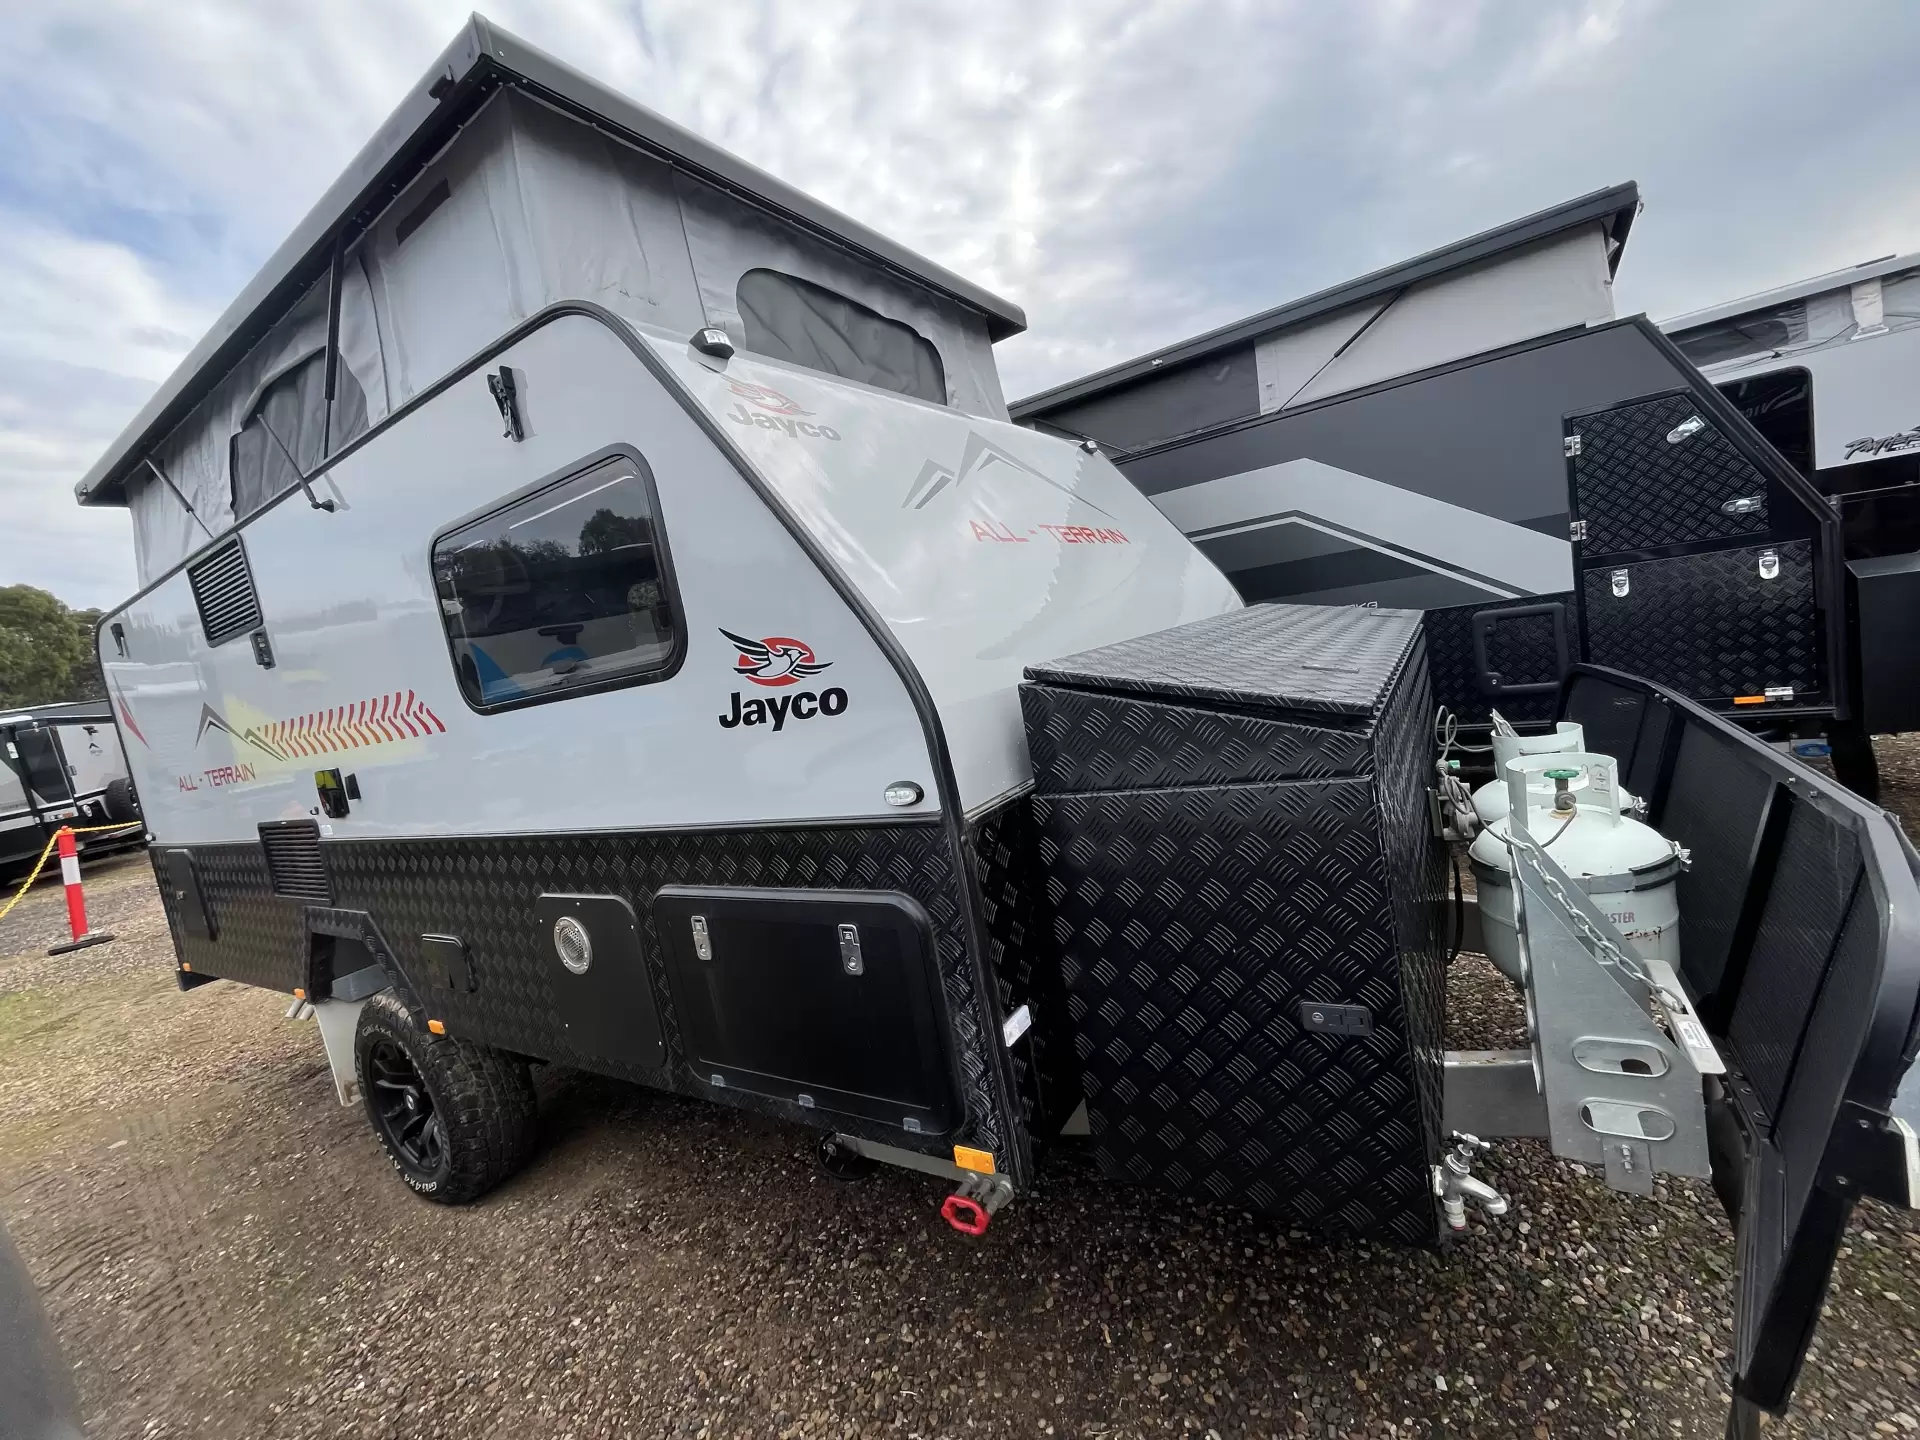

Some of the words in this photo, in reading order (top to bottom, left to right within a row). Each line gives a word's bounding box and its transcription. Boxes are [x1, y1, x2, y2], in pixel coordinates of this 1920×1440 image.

[727, 402, 842, 441] Jayco
[969, 519, 1029, 543] ALL
[1037, 524, 1131, 544] TERRAIN
[718, 687, 848, 732] Jayco
[179, 774, 199, 792] ALL
[204, 762, 256, 787] TERRAIN
[1604, 911, 1635, 924] STER
